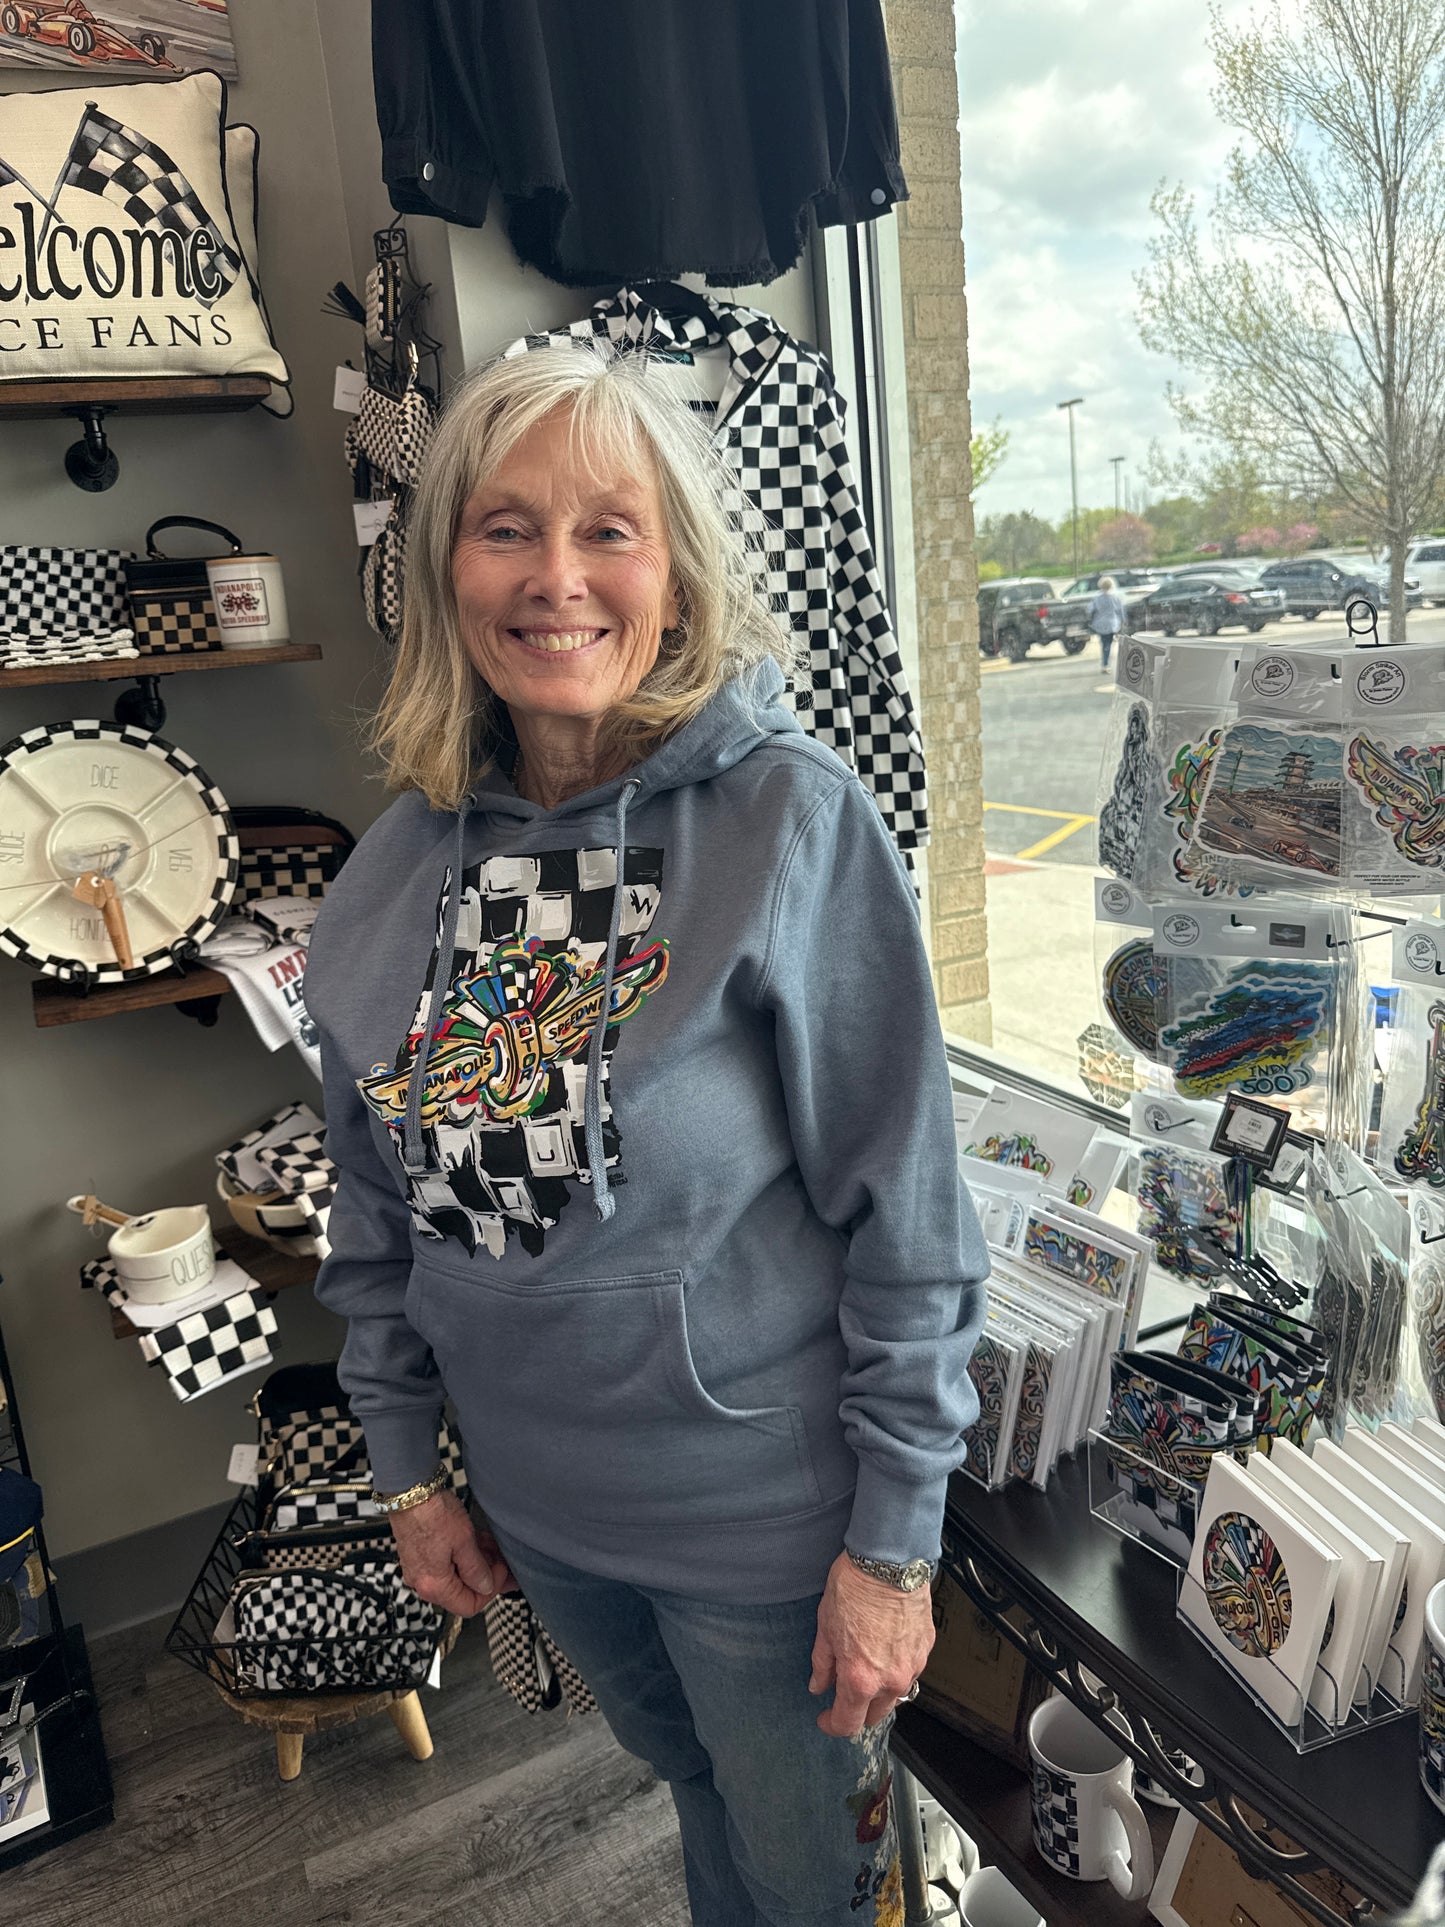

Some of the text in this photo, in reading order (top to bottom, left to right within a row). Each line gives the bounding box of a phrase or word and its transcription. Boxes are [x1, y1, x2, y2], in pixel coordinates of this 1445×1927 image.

[0, 200, 221, 301] elcome
[0, 313, 233, 352] CE FANS
[1360, 667, 1375, 680] Storm
[91, 765, 119, 789] DICE
[1370, 767, 1432, 815] INDIANAPOLIS
[169, 847, 192, 873] VEG
[1116, 954, 1153, 996] WELCOME
[548, 988, 619, 1040] SPEEDW
[515, 1016, 537, 1084] MOTOR
[1248, 1062, 1292, 1077] INDY
[397, 1051, 492, 1105] INANAPOLIS
[1240, 1075, 1294, 1094] 500
[171, 1239, 211, 1287] QUES
[1013, 1429, 1040, 1472] 500
[1155, 1434, 1177, 1476] MOTO
[1177, 1452, 1213, 1465] SPEEDW
[1260, 1576, 1281, 1643] MOTOR
